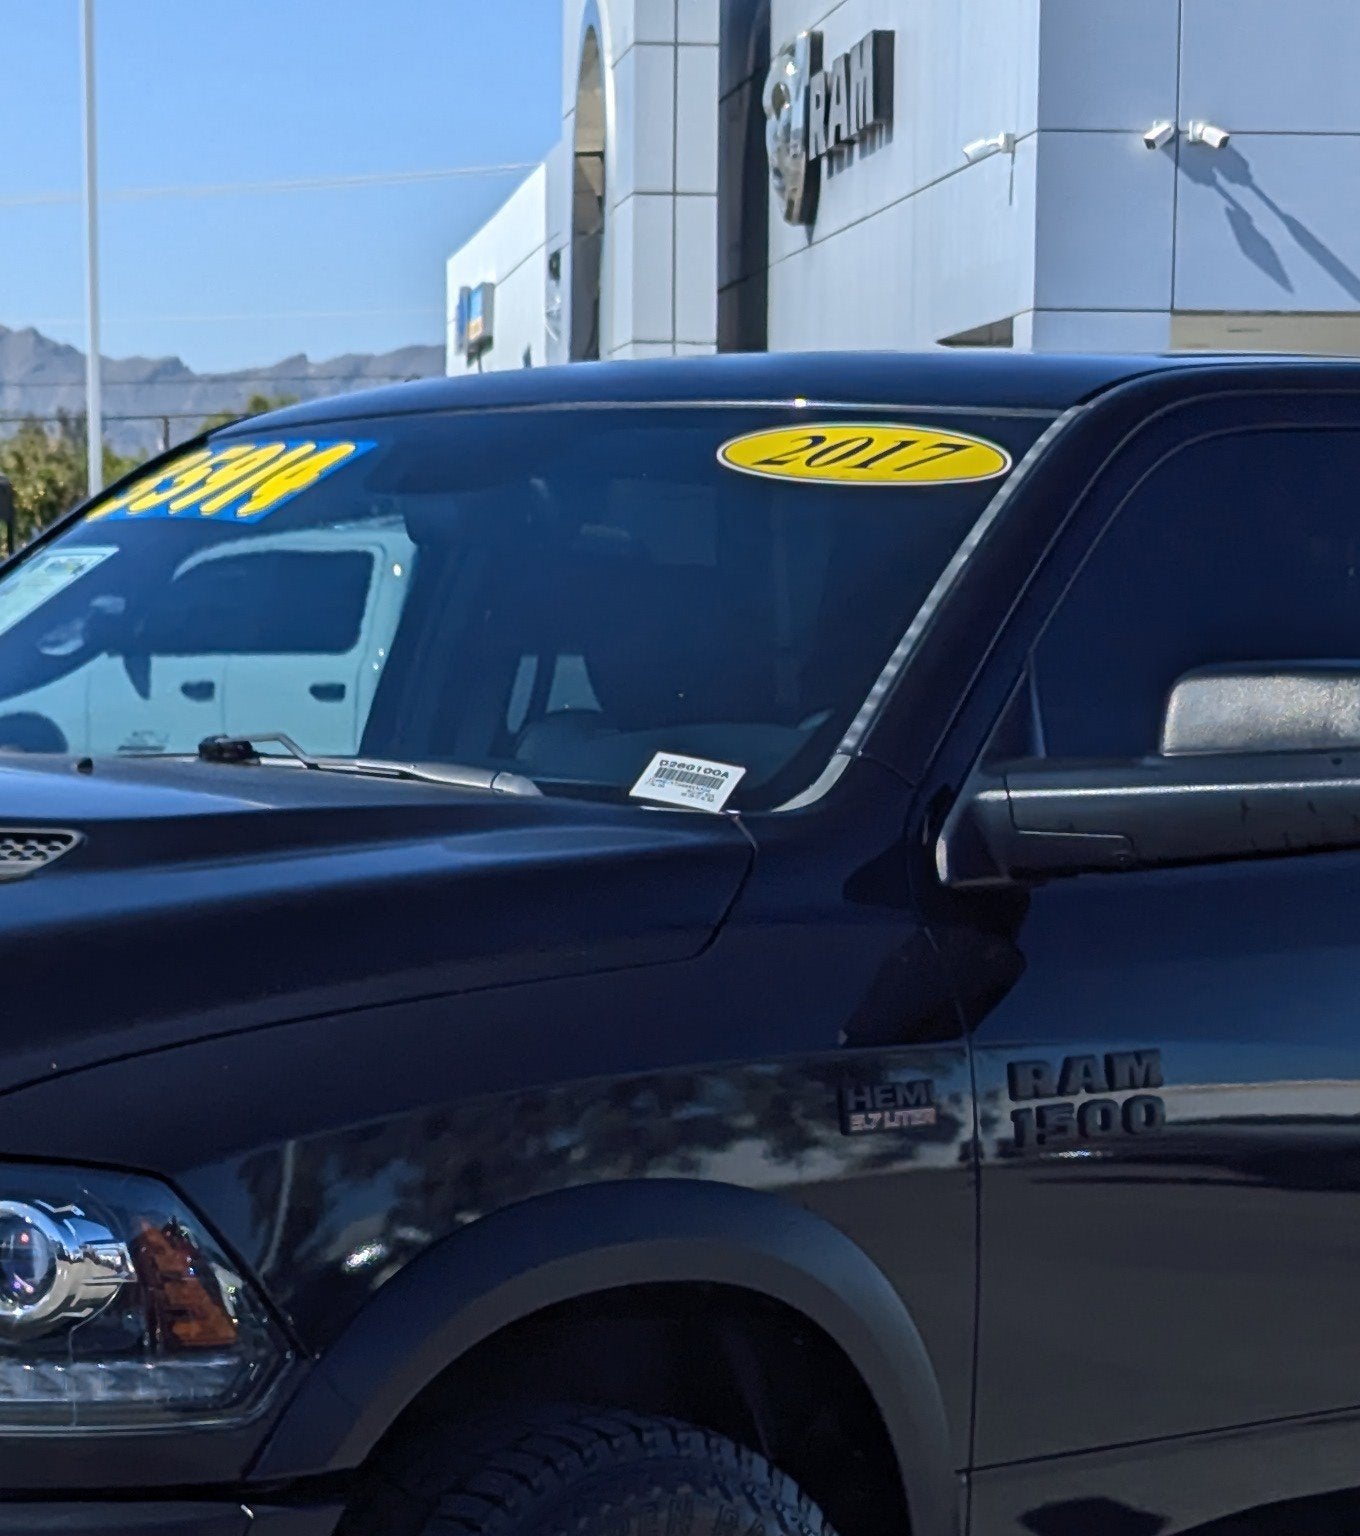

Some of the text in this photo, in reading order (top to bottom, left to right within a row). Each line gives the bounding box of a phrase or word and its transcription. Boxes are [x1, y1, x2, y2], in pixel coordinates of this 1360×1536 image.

[808, 31, 880, 161] RAM
[750, 435, 974, 472] 2017
[1007, 1048, 1164, 1101] RAM
[1010, 1094, 1165, 1148] 1500
